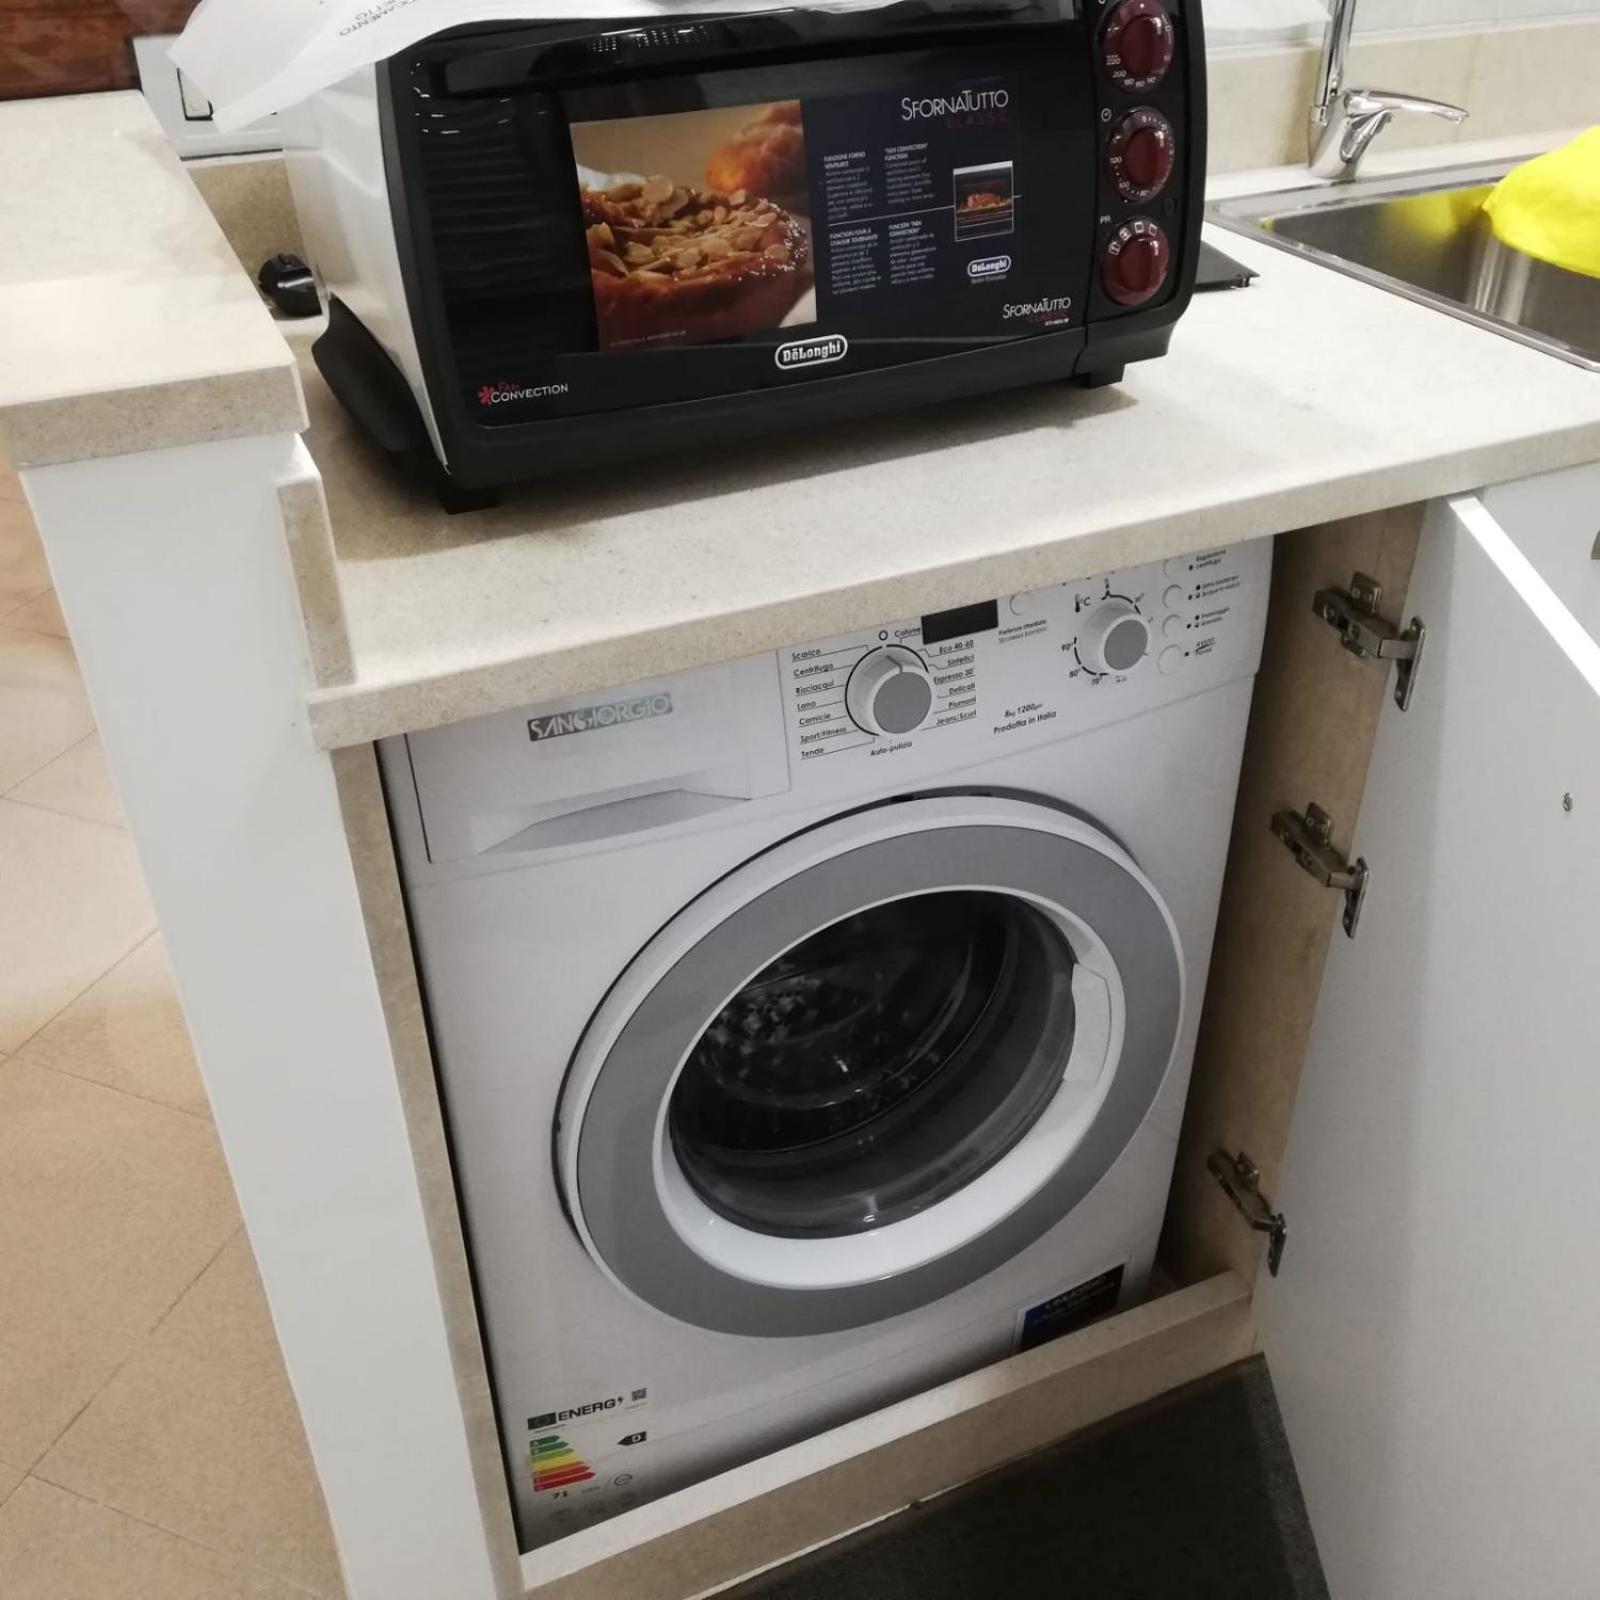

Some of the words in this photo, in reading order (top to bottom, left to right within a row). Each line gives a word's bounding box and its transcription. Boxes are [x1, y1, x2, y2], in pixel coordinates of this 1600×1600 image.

[491, 383, 569, 403] CONVECTION
[792, 648, 821, 660] Scarico
[939, 643, 953, 654] Eco
[793, 664, 834, 677] Centrifuga
[795, 680, 834, 694] Risciacqui
[797, 701, 816, 711] Lana
[799, 713, 831, 725] Camicie
[993, 719, 1027, 735] Prodotta
[1028, 715, 1036, 726] in
[1037, 710, 1057, 723] Italia
[800, 728, 847, 742] Sport/Fitness
[801, 748, 824, 758] Tende
[870, 741, 913, 756] Auto-pulizia
[558, 1399, 616, 1422] ENERG
